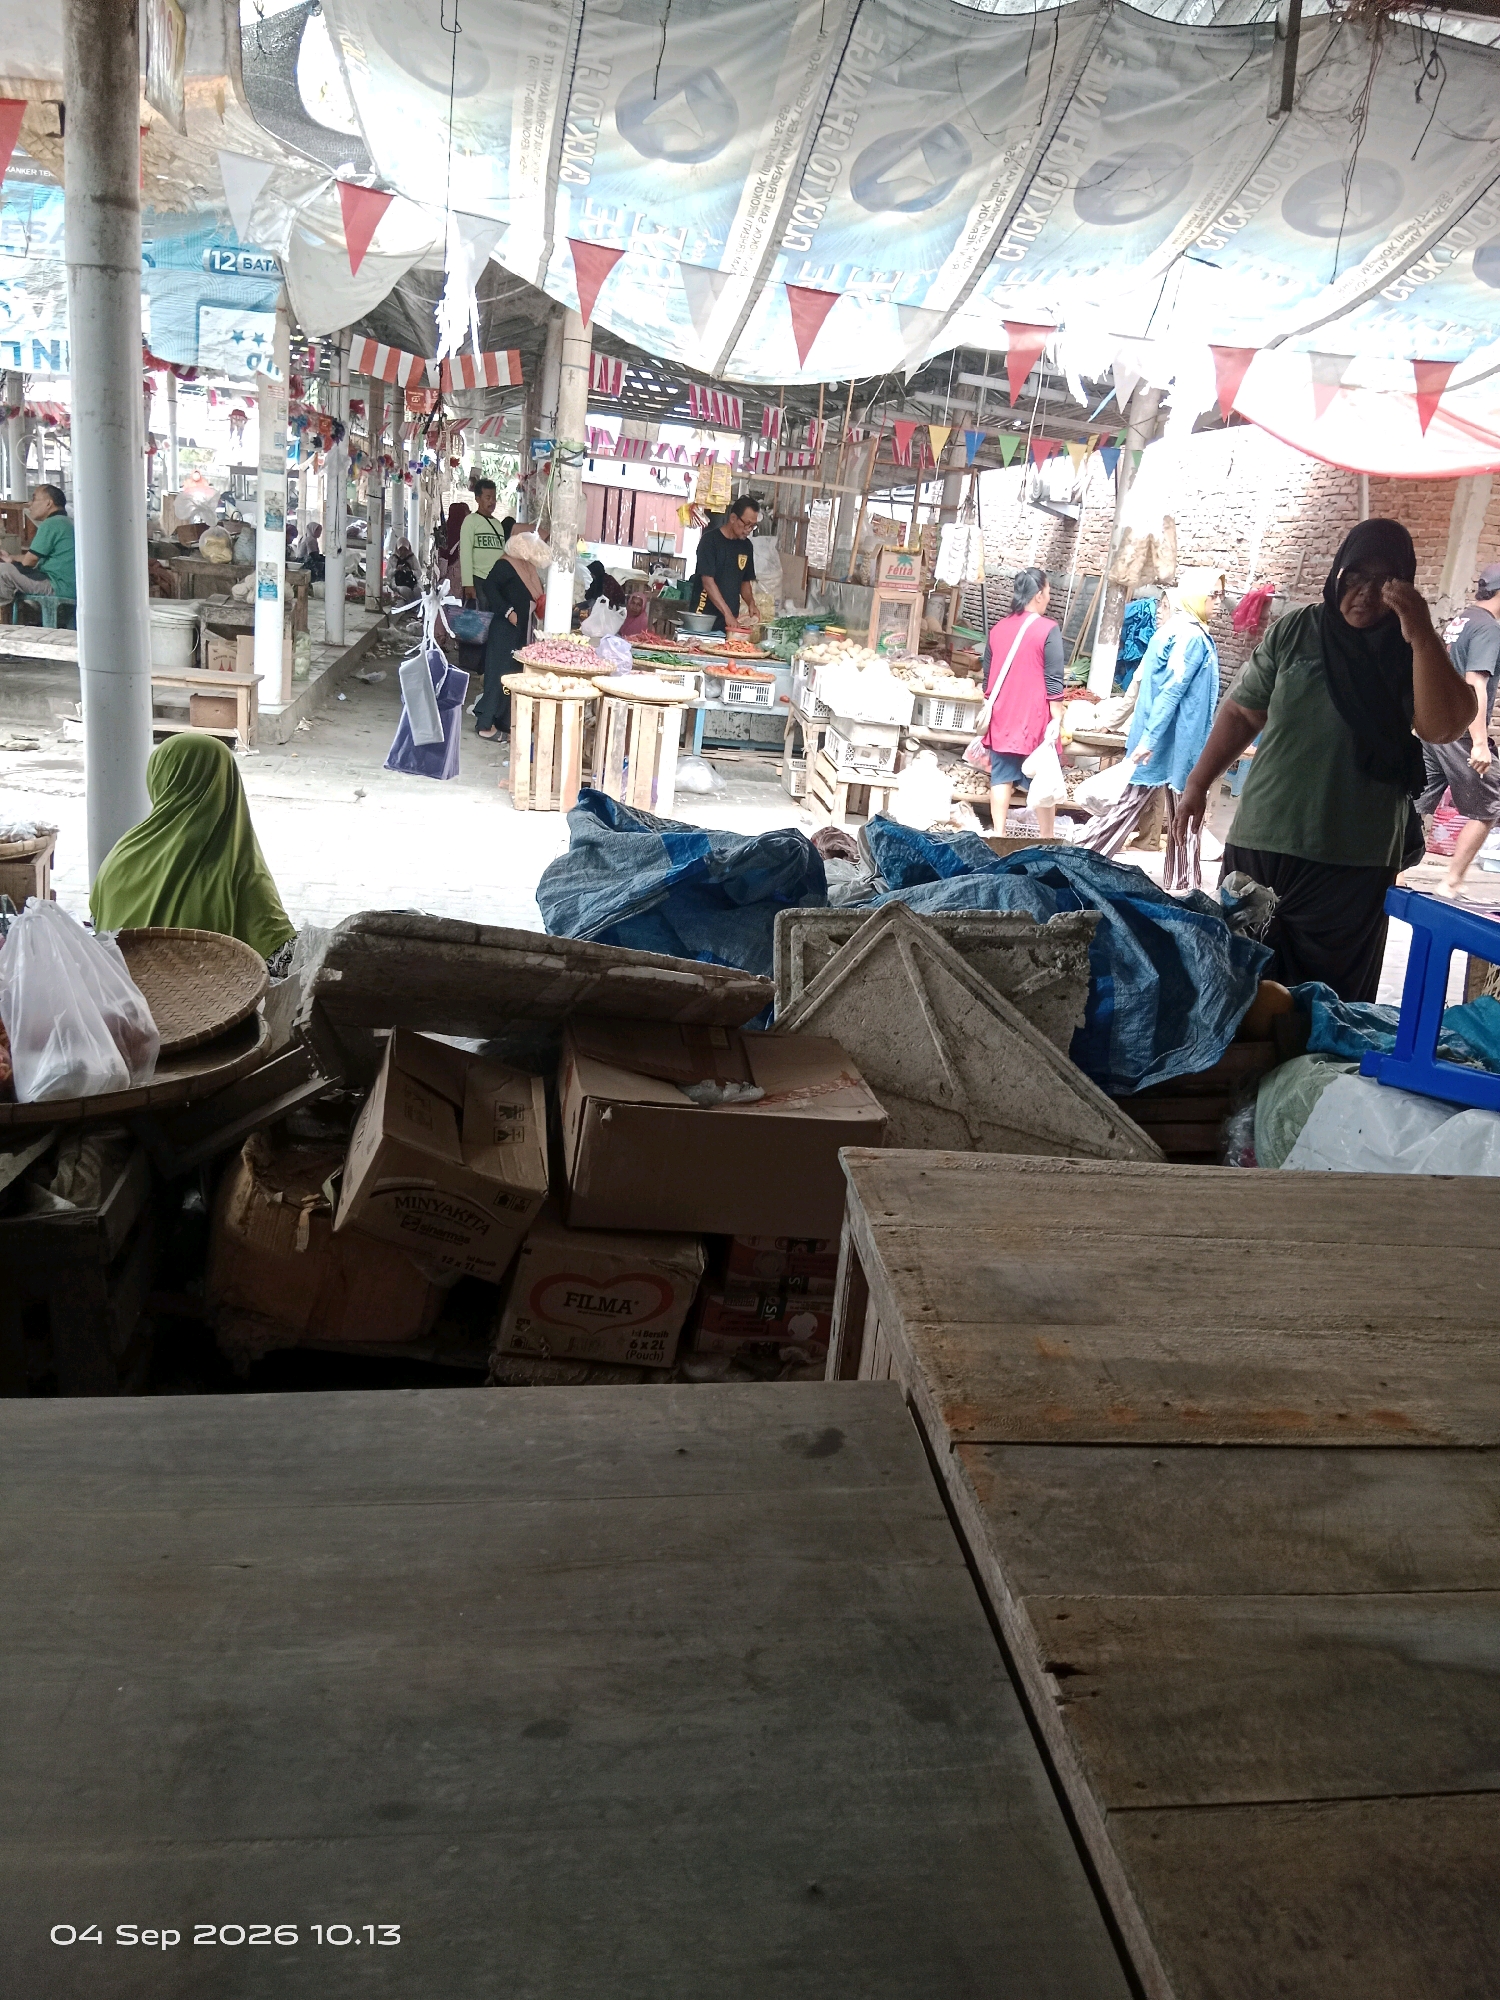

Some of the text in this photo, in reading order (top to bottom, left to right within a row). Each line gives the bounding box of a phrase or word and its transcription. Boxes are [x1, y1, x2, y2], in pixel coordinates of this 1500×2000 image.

[211, 251, 236, 271] 12
[394, 1196, 491, 1236] MINYAKITA
[419, 1221, 471, 1245] sinarmas
[441, 1255, 450, 1264] 12
[465, 1261, 476, 1271] 1L
[563, 1292, 633, 1315] FILMA
[643, 1330, 669, 1338] Bersih
[629, 1340, 637, 1349] 6
[651, 1341, 665, 1350] 2L
[625, 1350, 664, 1363] (Pouch)
